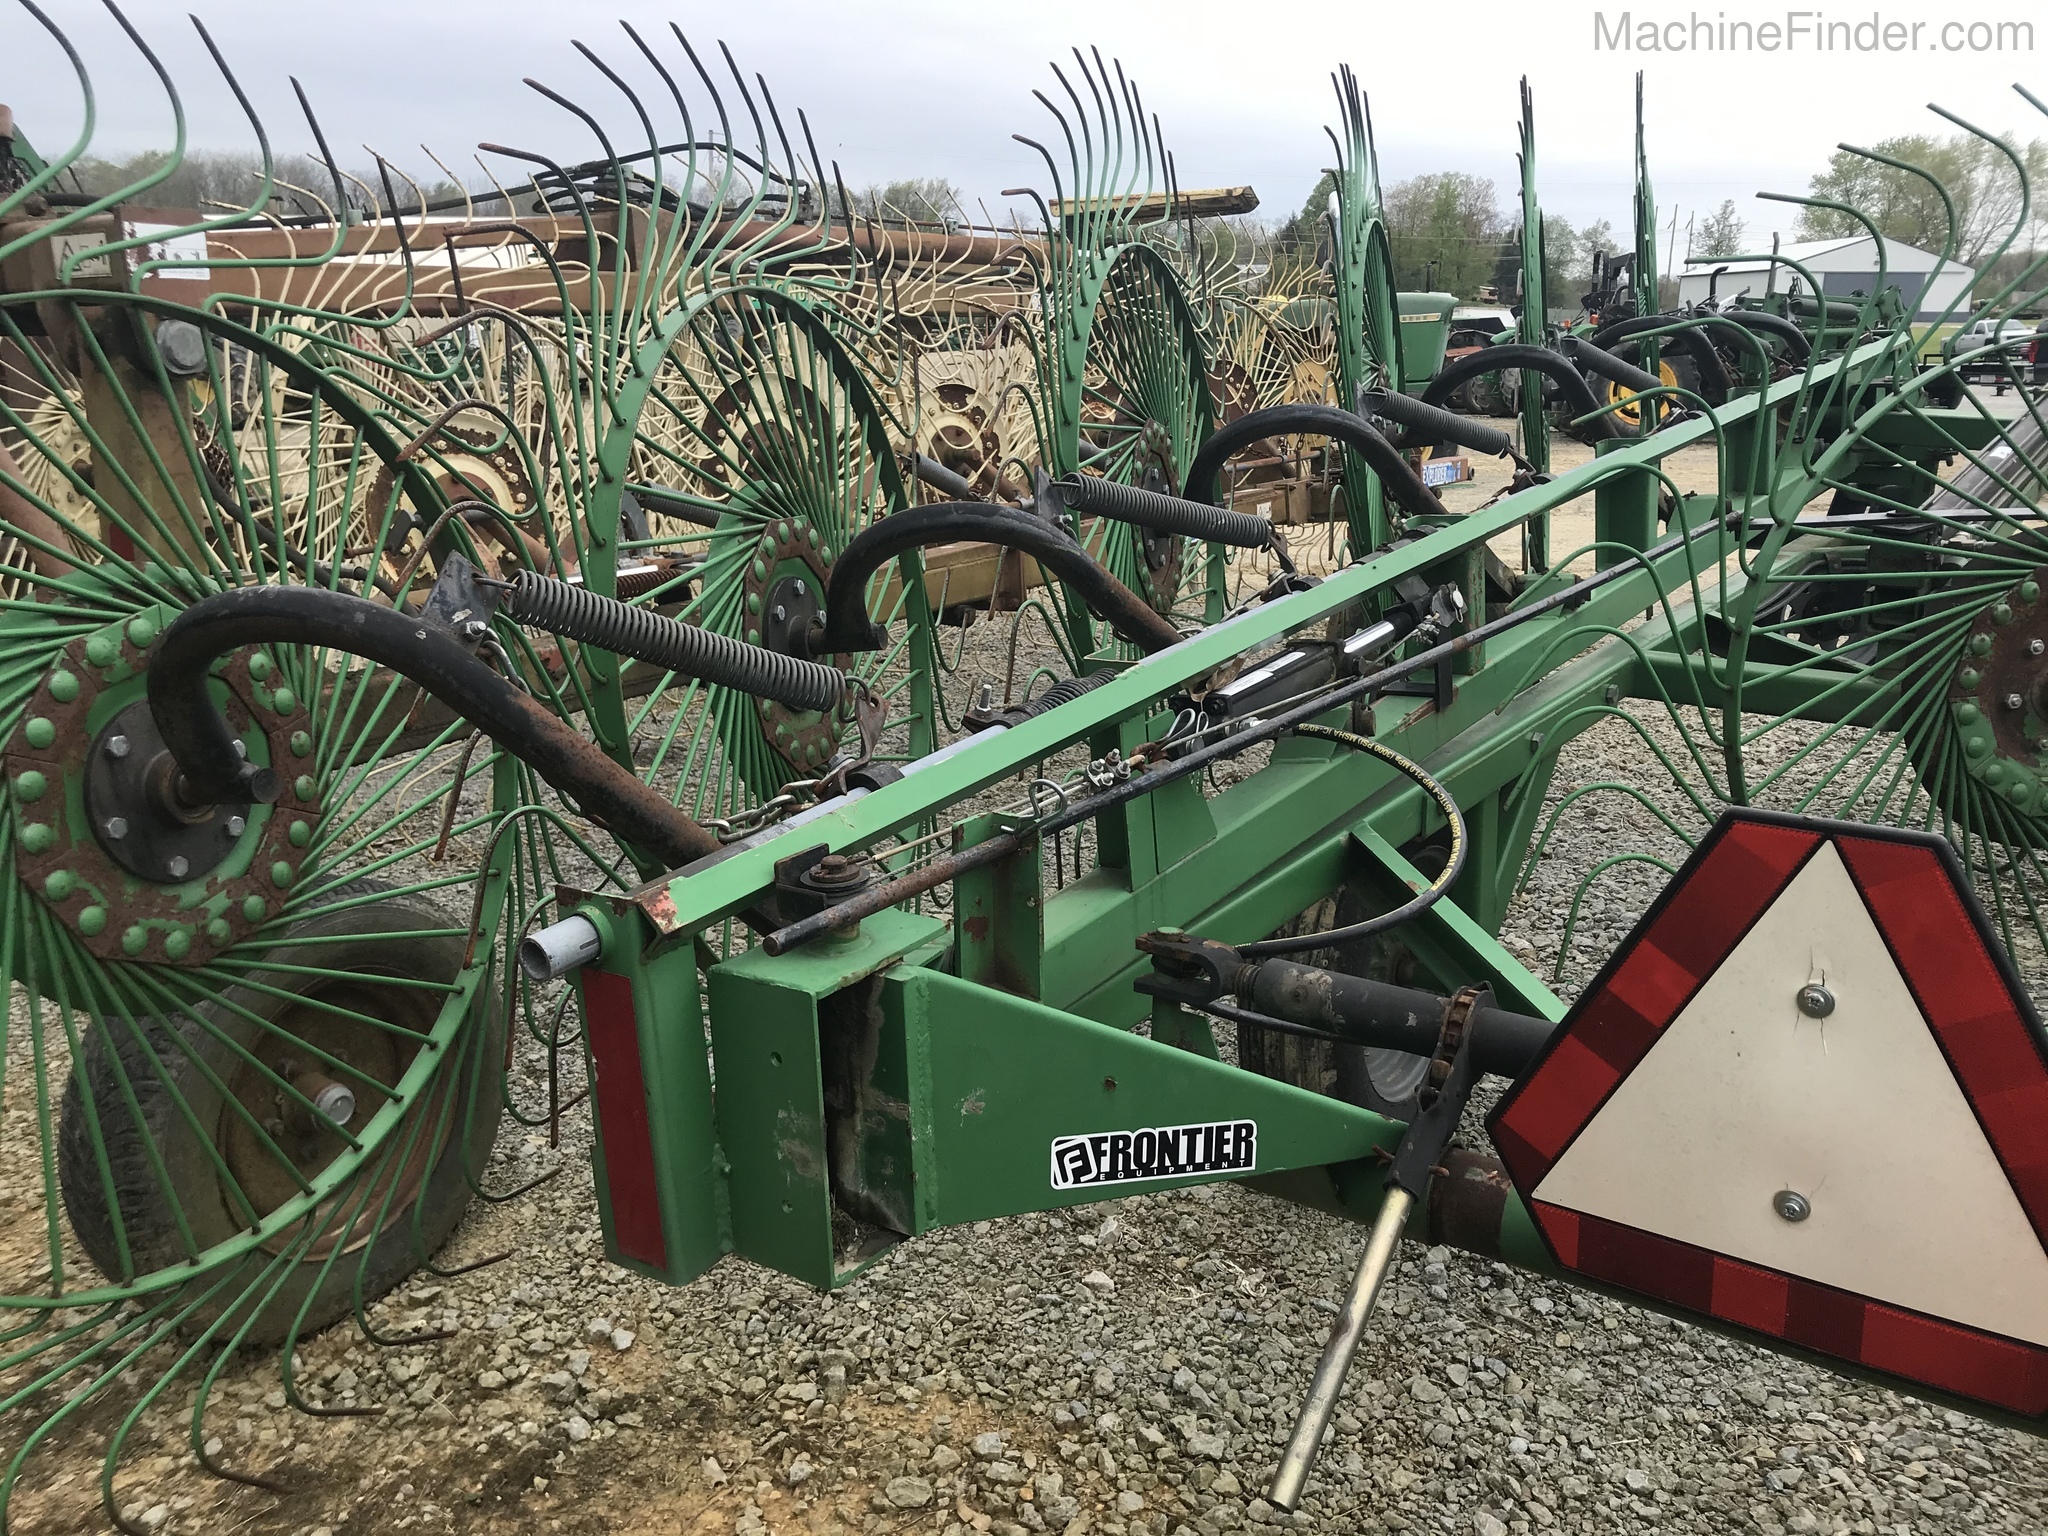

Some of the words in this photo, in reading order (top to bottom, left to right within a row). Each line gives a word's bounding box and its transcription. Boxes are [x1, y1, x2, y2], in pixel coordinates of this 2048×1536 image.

[1333, 729, 1357, 743] MSHA
[1357, 736, 1374, 750] PSI)
[1395, 755, 1411, 769] MPa
[1409, 765, 1425, 779] 21.0
[1421, 777, 1435, 790] WP
[1449, 812, 1461, 838] COVER
[1094, 1123, 1254, 1173] FRONTIER
[1099, 1160, 1246, 1181] EQUIPMENT
